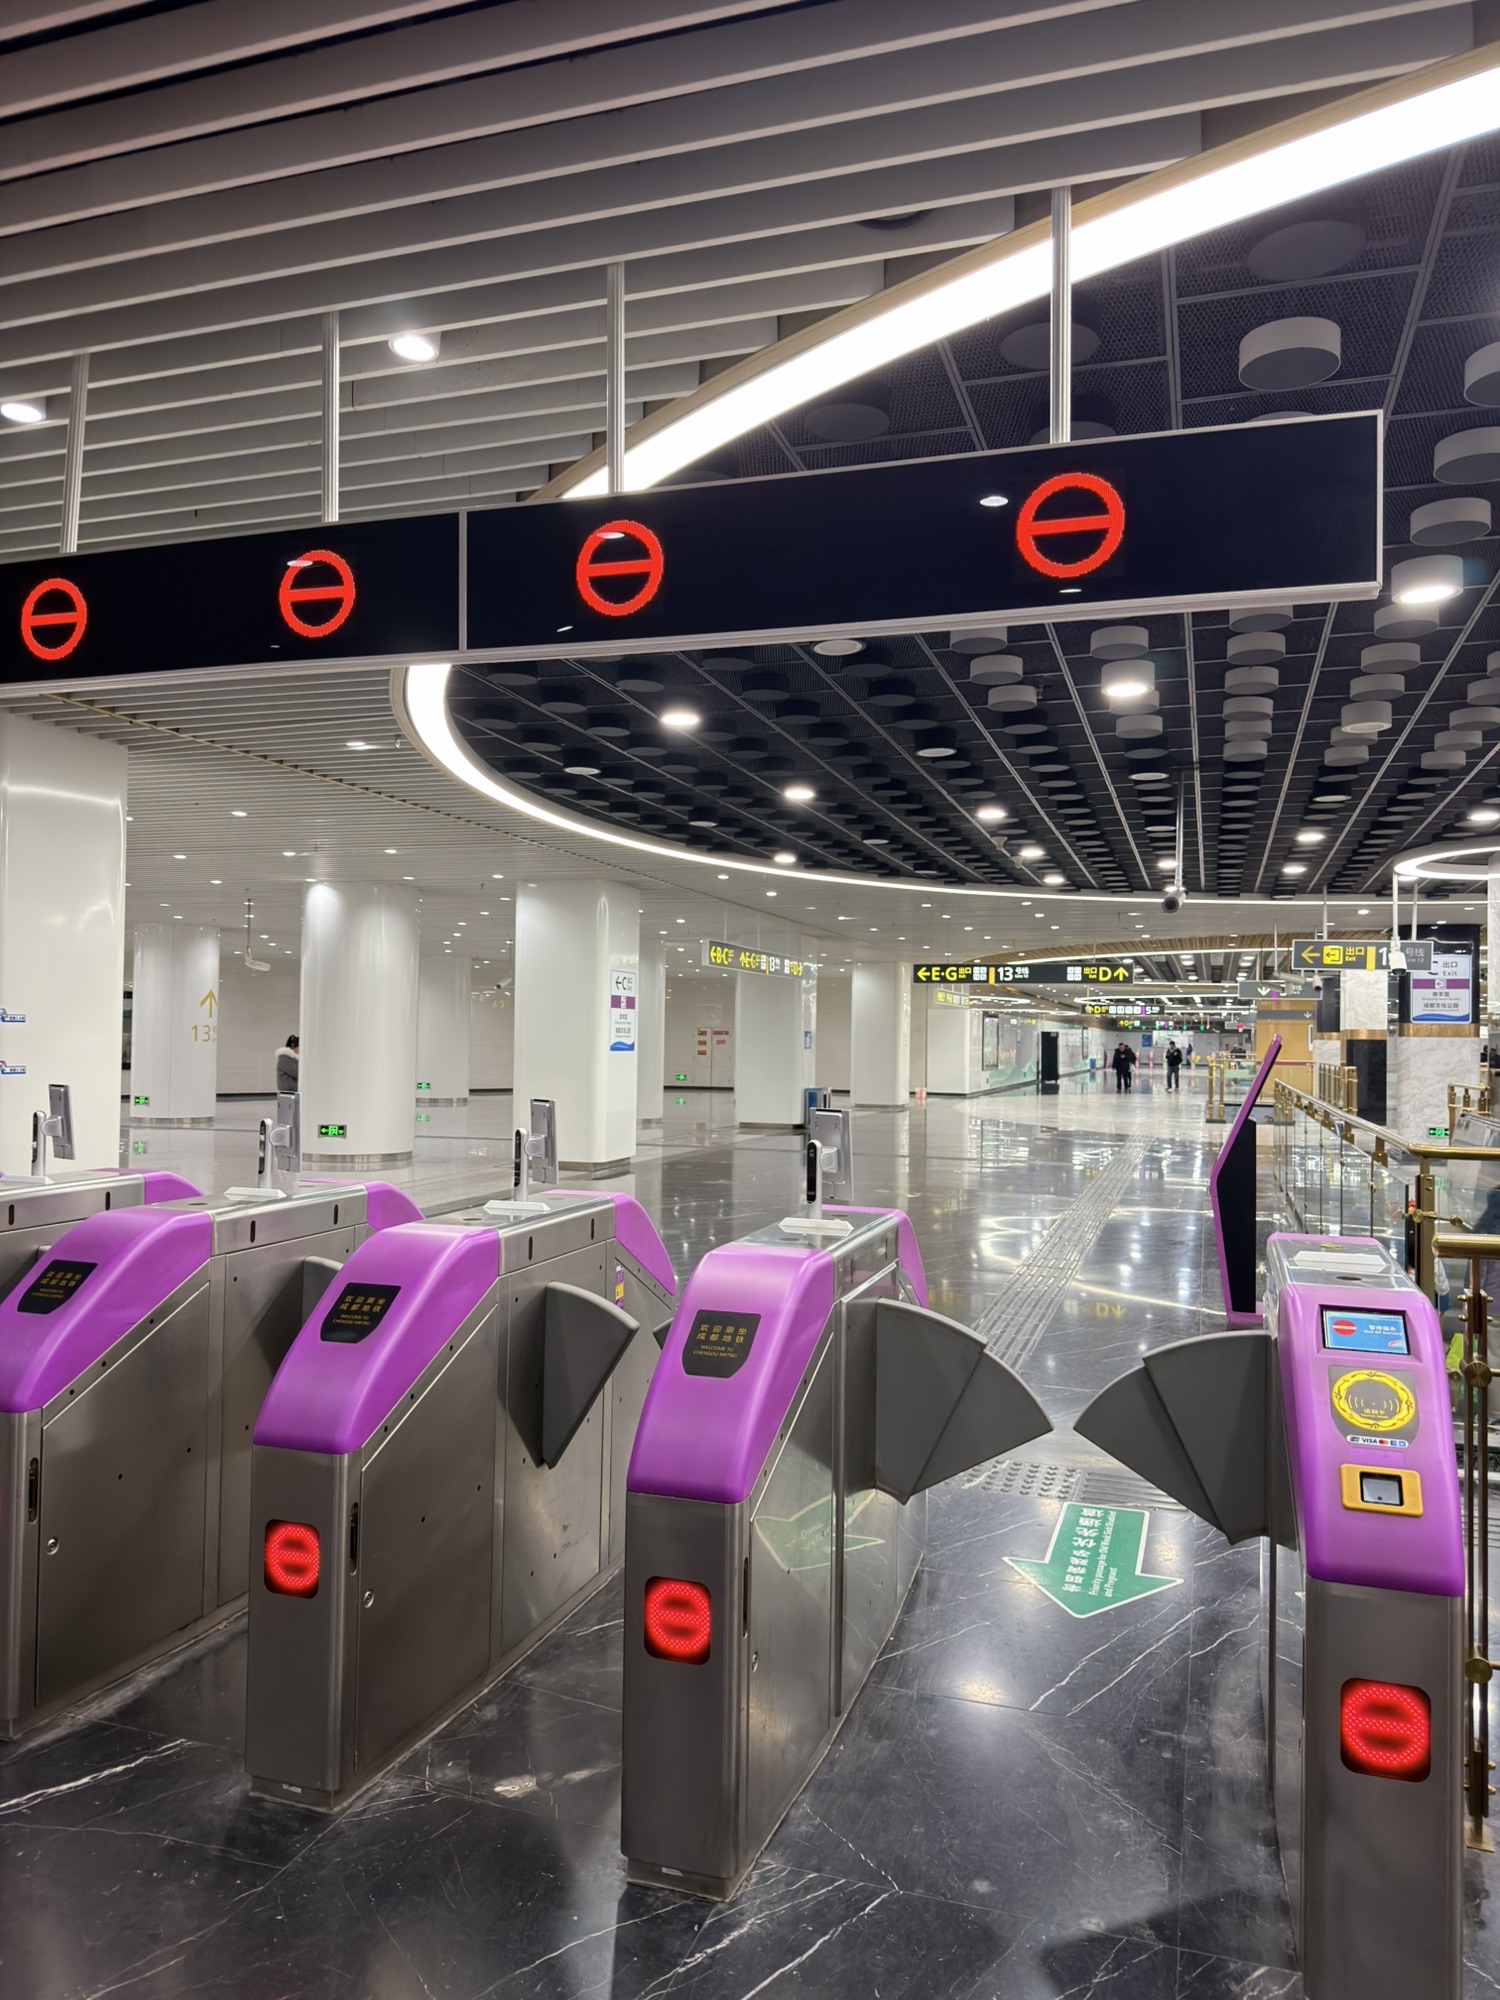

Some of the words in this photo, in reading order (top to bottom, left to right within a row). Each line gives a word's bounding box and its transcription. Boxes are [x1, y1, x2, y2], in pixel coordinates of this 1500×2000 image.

[1345, 946, 1365, 955] 出口
[1406, 947, 1425, 957] 号线
[997, 967, 1013, 981] 13
[1099, 966, 1112, 981] D
[622, 976, 627, 990] C
[1094, 1006, 1101, 1014] D
[191, 1024, 210, 1042] 13
[700, 1324, 747, 1336] 欢迎乘坐
[696, 1332, 744, 1344] 成都地铁
[1062, 1507, 1104, 1592] 老弱病残孕优先通道
[1088, 1577, 1102, 1595] Priority
[1095, 1559, 1106, 1578] passage
[1104, 1566, 1116, 1588] Pregnant
[1103, 1588, 1113, 1597] and
